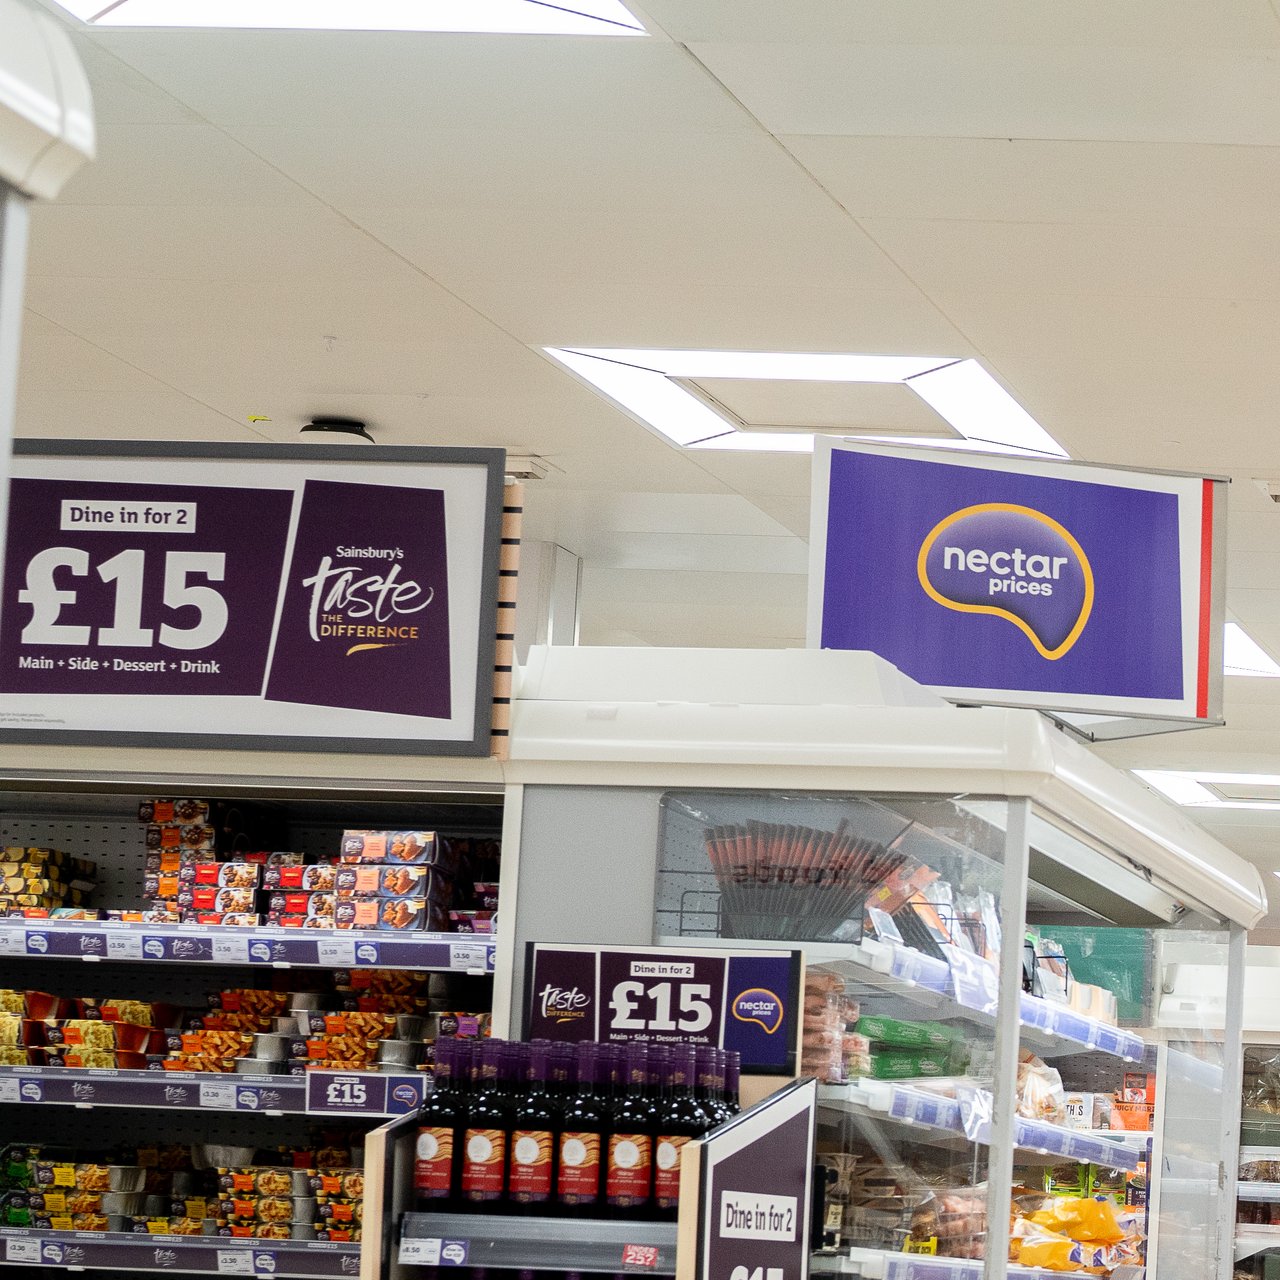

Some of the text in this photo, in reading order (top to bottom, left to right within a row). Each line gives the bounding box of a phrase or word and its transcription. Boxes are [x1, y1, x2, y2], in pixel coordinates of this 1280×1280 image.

[70, 506, 188, 524] Dine in for 2
[336, 546, 404, 560] Sainsbury's
[944, 546, 1068, 580] nectar
[989, 575, 1053, 596] prices
[18, 546, 229, 650] £15
[302, 556, 434, 642] taste
[322, 614, 343, 622] THE
[320, 624, 418, 638] DIFFERENCE
[19, 656, 54, 670] Main
[68, 657, 99, 670] Side
[113, 658, 166, 672] Dessert
[180, 660, 220, 674] Drink
[634, 964, 692, 975] Dine in for 2
[539, 984, 590, 1018] taste
[609, 981, 712, 1032] £15
[739, 1000, 776, 1011] nectar
[610, 1033, 710, 1044] Main Side Dessert Drink
[326, 1084, 368, 1104] £15
[726, 1202, 793, 1233] Dine in for 2
[625, 1252, 655, 1266] 25?
